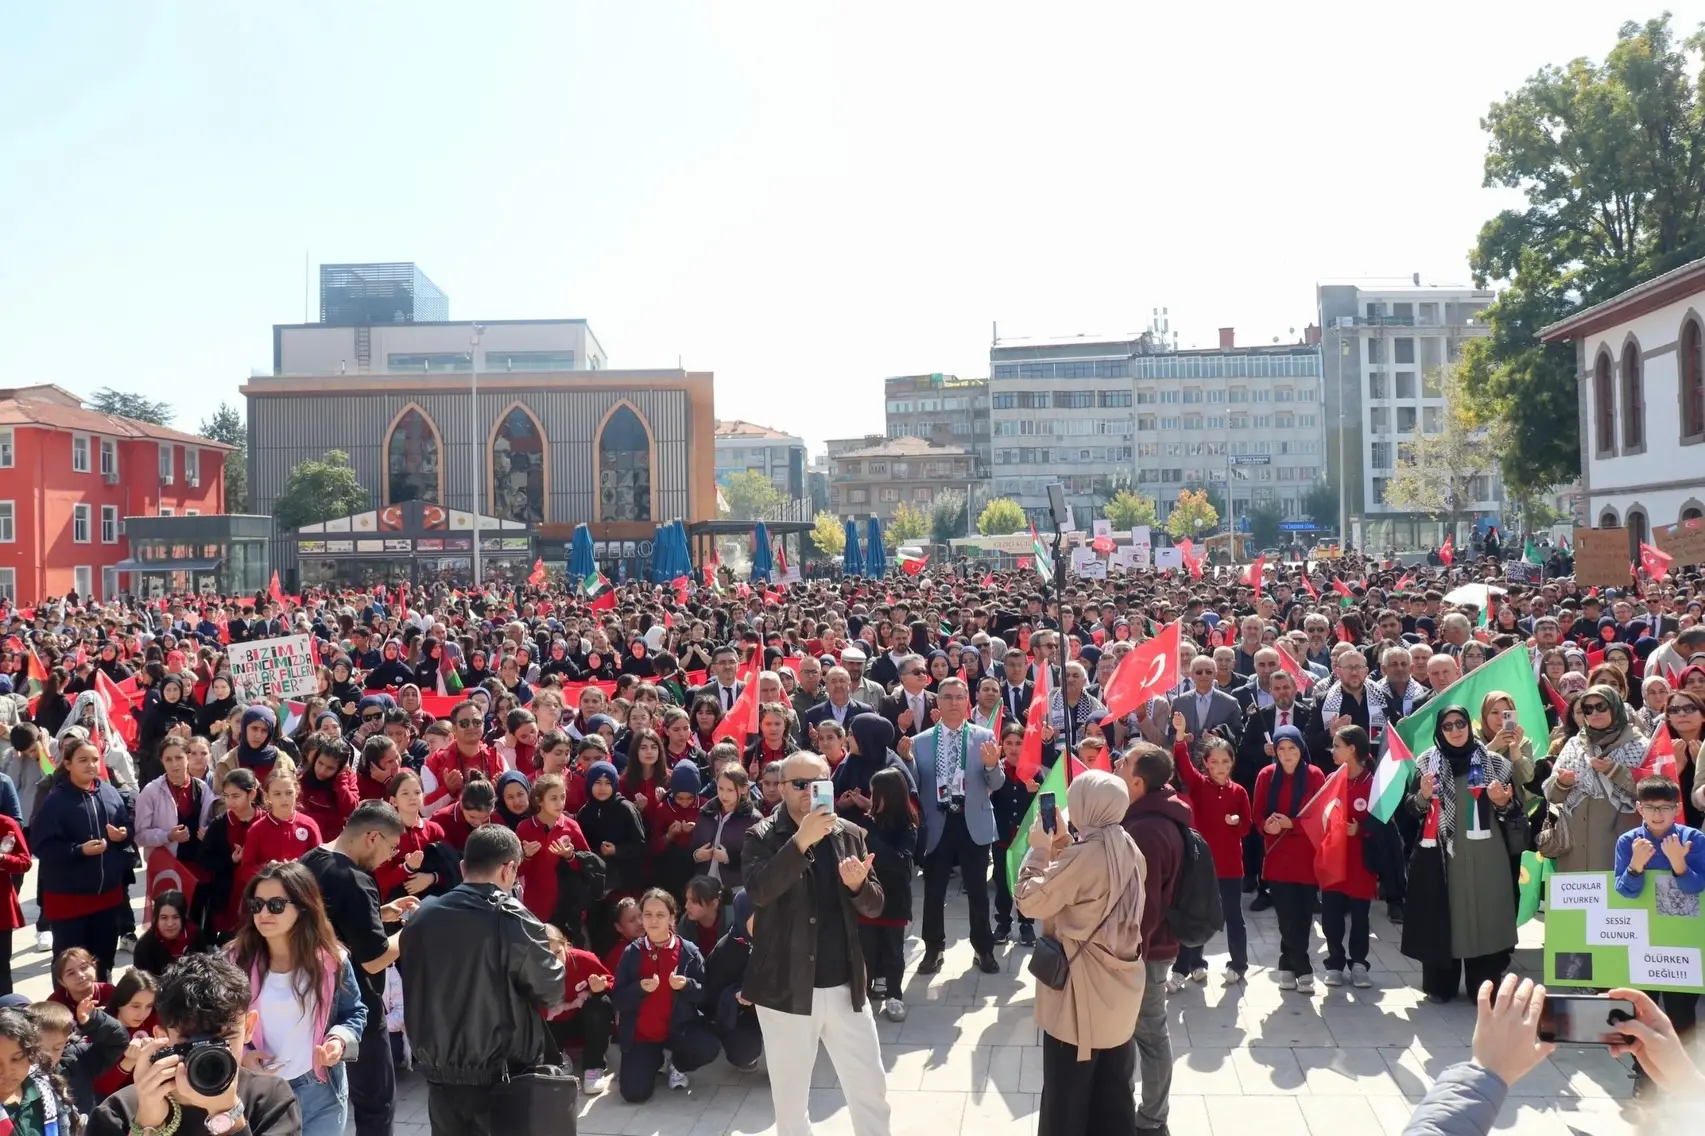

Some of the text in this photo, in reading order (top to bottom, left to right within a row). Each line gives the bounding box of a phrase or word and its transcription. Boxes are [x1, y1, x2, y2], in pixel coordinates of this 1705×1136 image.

[564, 540, 653, 559] ZFERO
[1561, 882, 1601, 891] ÇOCUKLAR
[1563, 896, 1599, 904] UYURKEN
[1606, 916, 1631, 925] SESSİZ
[1600, 931, 1638, 940] OLUNUR.
[1644, 954, 1689, 964] ÖLÜRKEN
[1648, 968, 1687, 979] DEĞİL!!!
